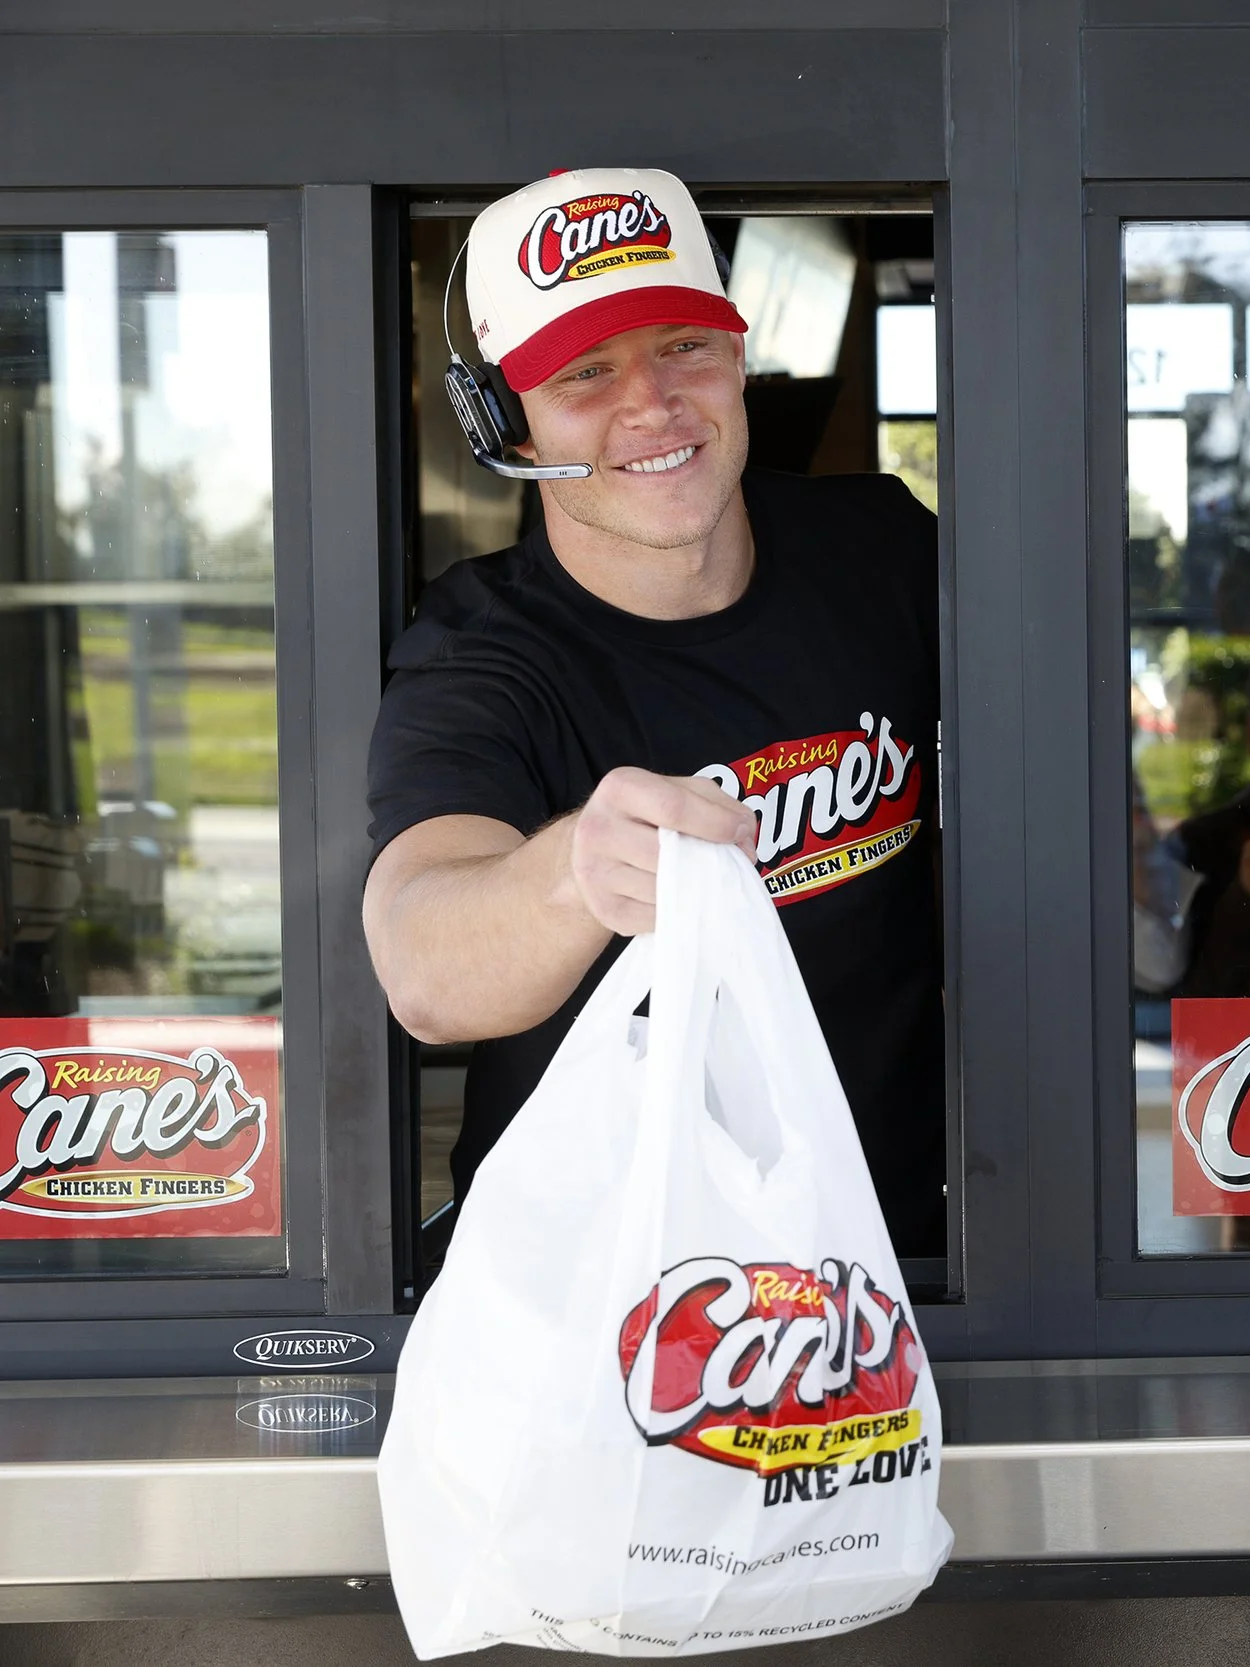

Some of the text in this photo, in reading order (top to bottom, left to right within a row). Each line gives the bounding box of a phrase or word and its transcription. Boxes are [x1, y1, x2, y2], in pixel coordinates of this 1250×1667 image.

[567, 197, 619, 218] Raising
[528, 191, 664, 287] Cane's
[576, 254, 625, 276] CHICKEN
[745, 739, 838, 790] Raising
[765, 825, 912, 895] CHICKEN FINGERS
[52, 1060, 162, 1090] Raising
[47, 1178, 225, 1196] CHICKEN FINGERS
[752, 1270, 824, 1308] Raisi
[732, 1426, 809, 1455] CHKEN
[764, 1463, 839, 1507] ONE
[703, 1631, 722, 1640] TO
[758, 1618, 836, 1636] RECYCLED
